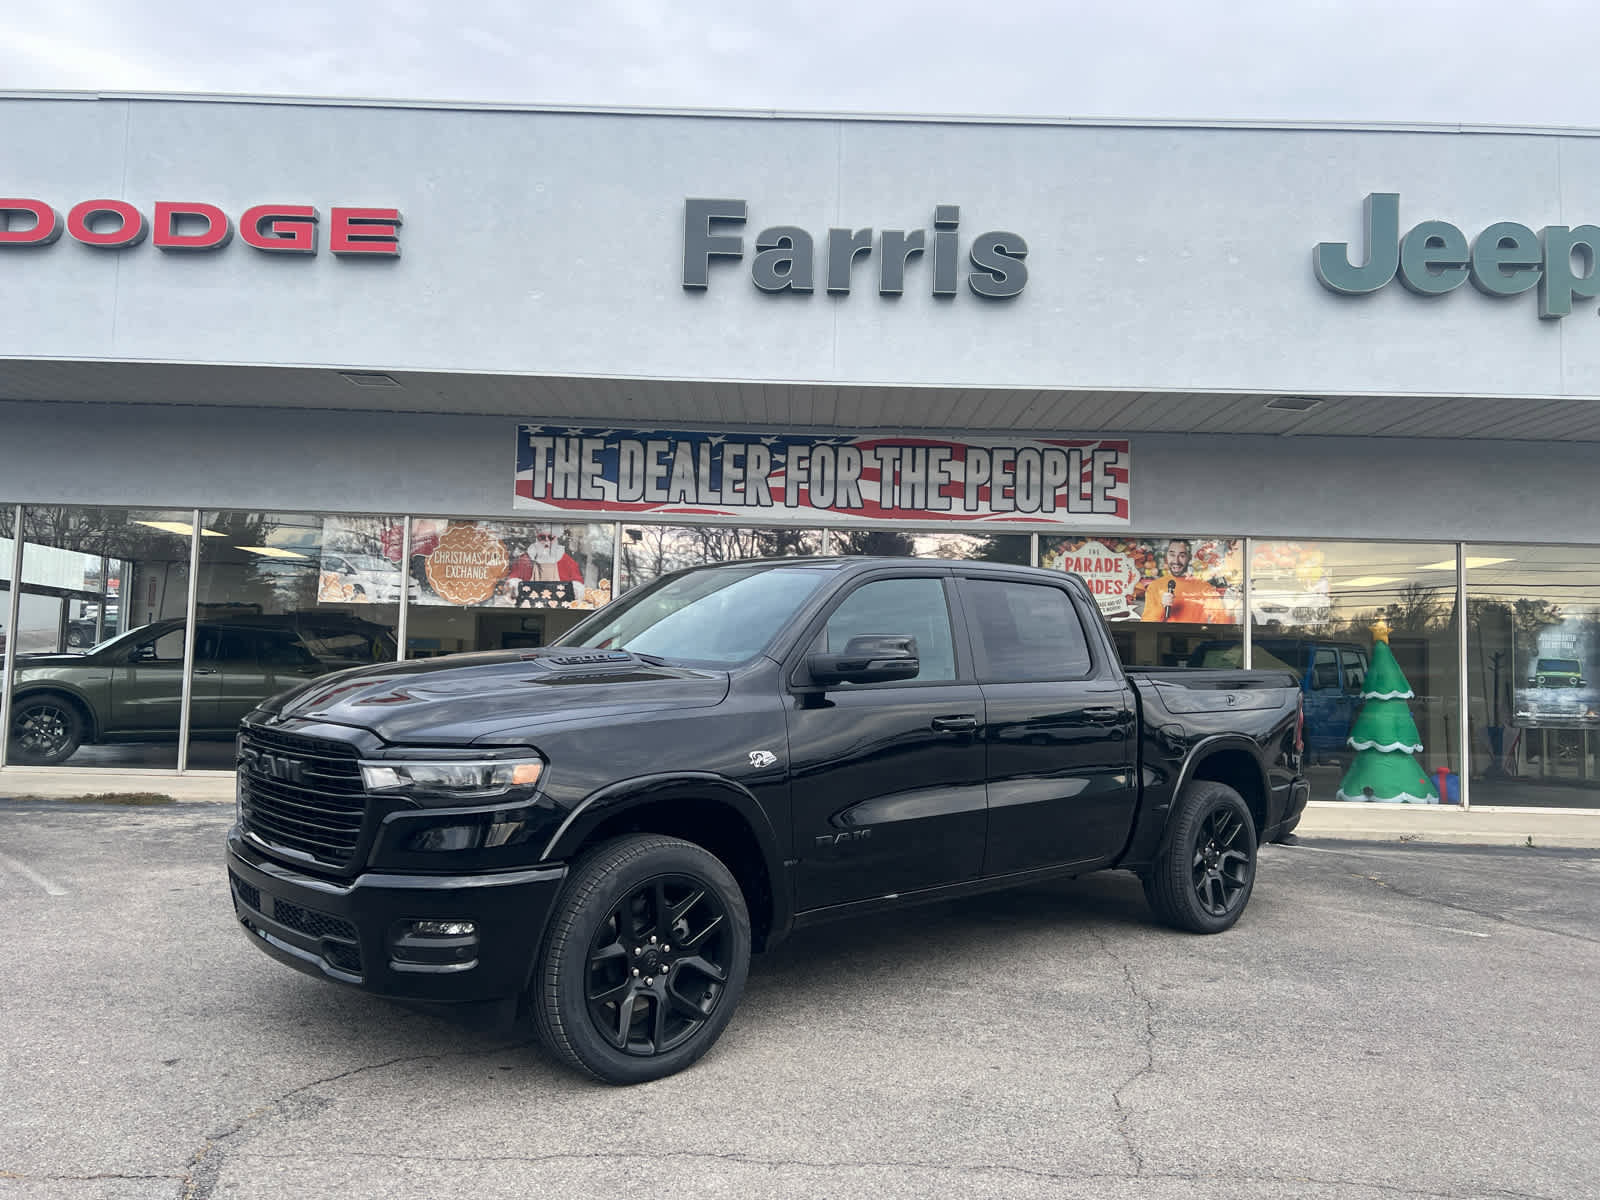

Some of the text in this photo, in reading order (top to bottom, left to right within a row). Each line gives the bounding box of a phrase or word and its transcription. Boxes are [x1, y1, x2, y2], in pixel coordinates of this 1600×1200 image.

[0, 198, 402, 256] DODGE
[682, 198, 1029, 299] Farris
[1312, 193, 1600, 319] Jeep
[529, 435, 1119, 514] THE DEALER FOR THE PEOPLE
[434, 551, 501, 566] CHRISTMAS CAR
[445, 565, 489, 580] EXCHANGE
[1065, 557, 1123, 573] PARADE
[1087, 579, 1123, 595] ADES
